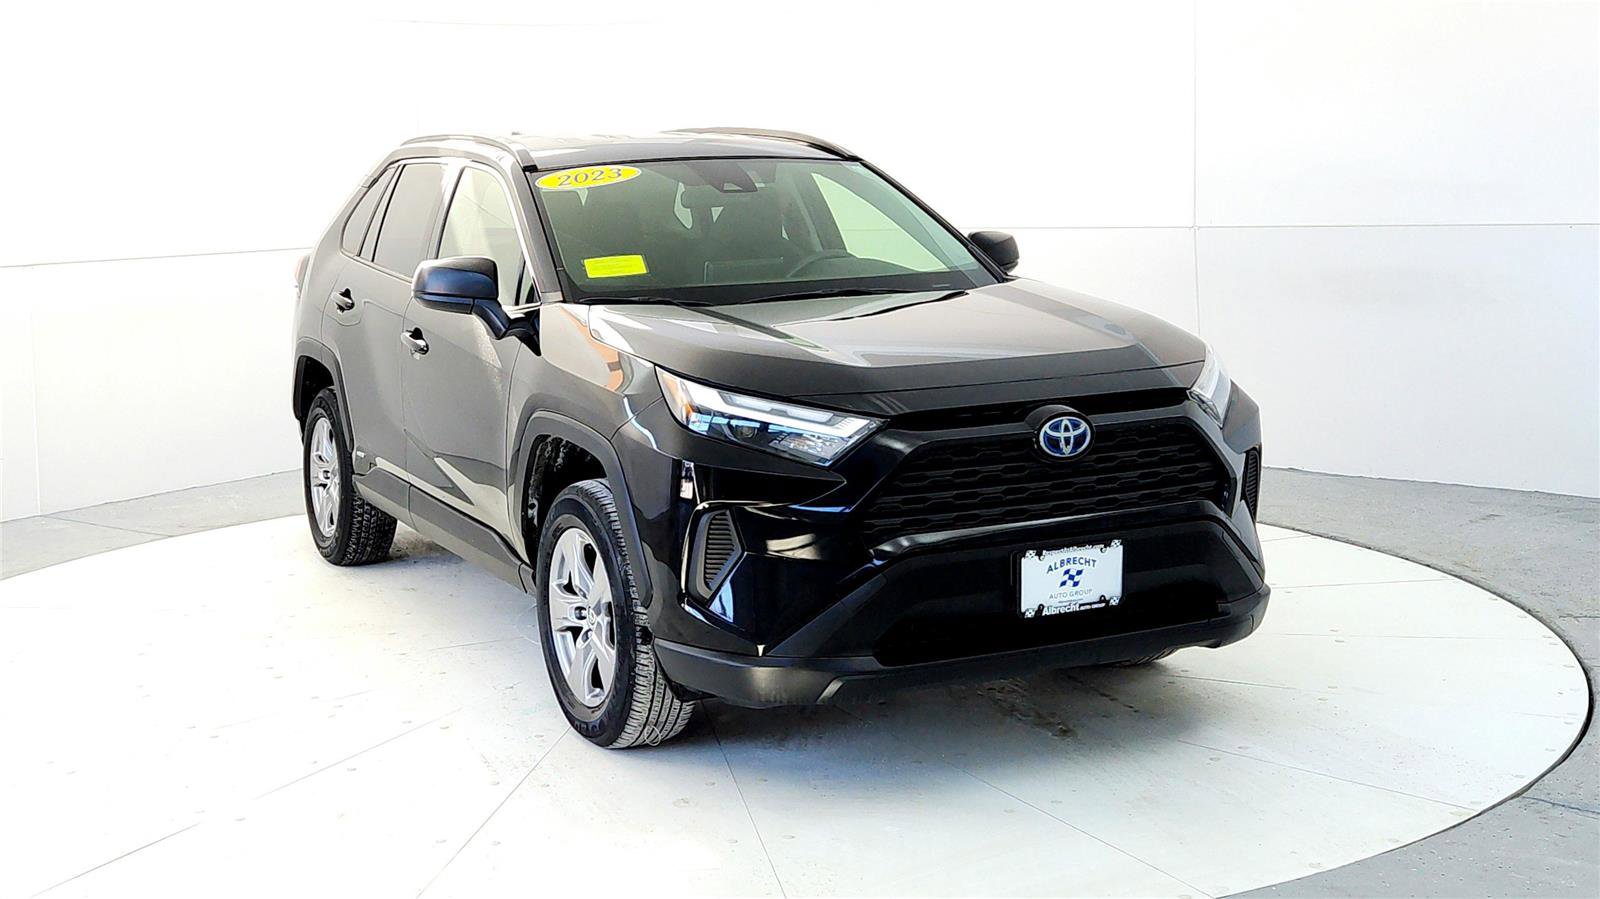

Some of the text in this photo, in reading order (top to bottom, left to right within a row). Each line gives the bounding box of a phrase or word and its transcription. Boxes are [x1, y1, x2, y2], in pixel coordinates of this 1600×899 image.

[557, 168, 622, 187] 2023
[1046, 556, 1097, 574] ALBRECHT
[1049, 588, 1092, 600] AUTO GROUP
[1042, 602, 1080, 617] Albrecht
